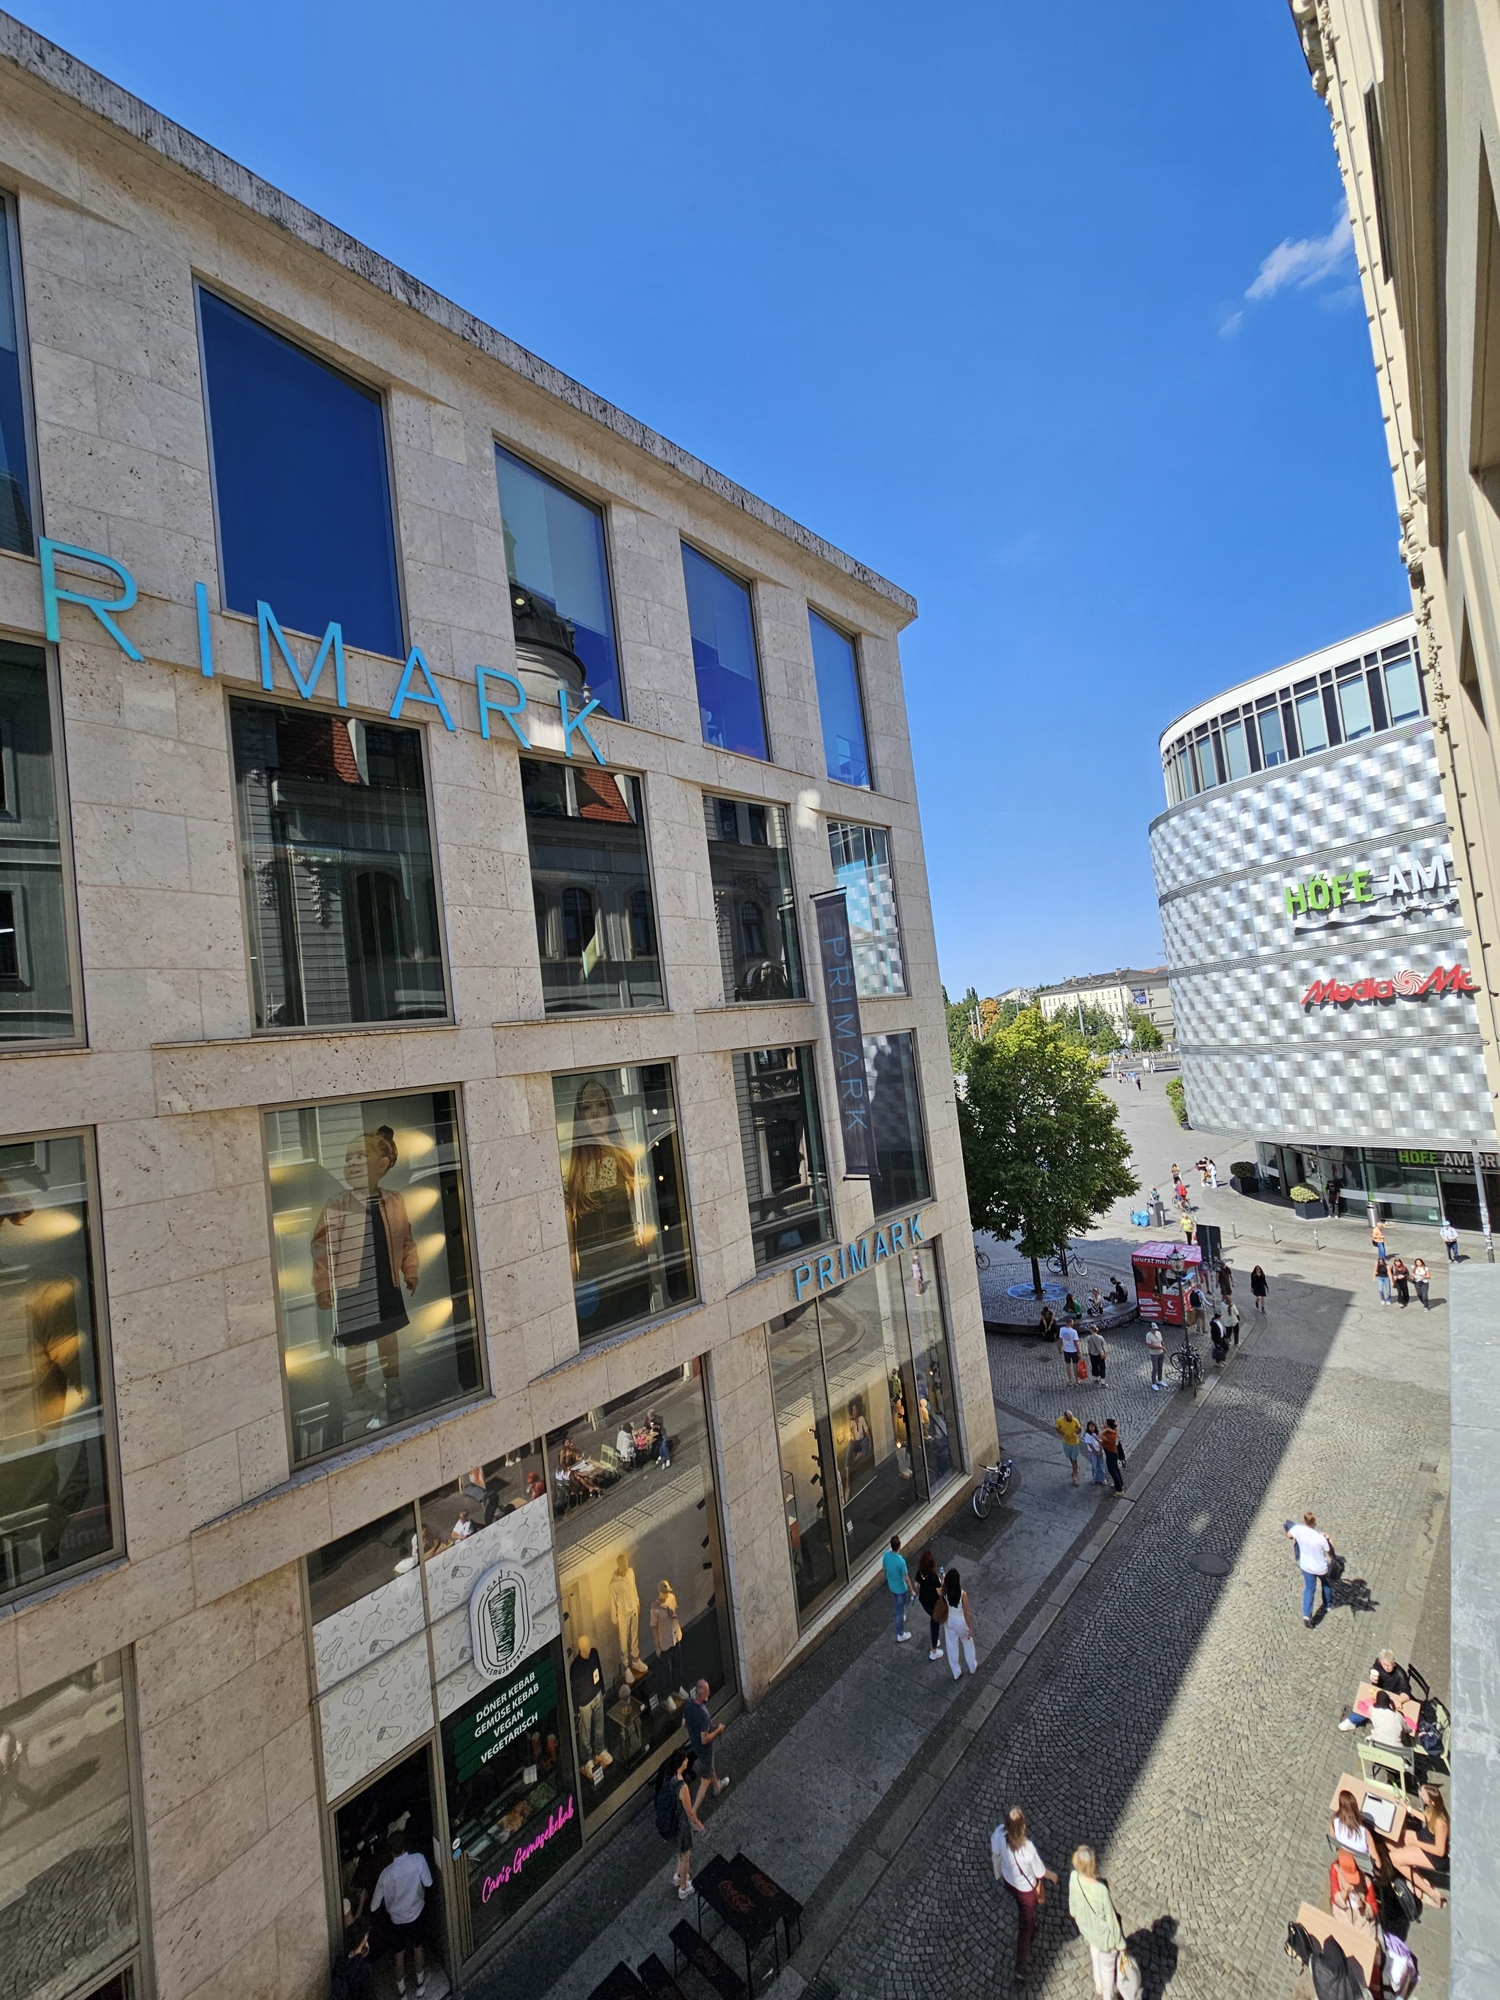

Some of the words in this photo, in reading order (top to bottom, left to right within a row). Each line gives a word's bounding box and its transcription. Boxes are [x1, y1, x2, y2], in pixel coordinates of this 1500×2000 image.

[39, 537, 608, 766] RIMARK
[1285, 870, 1374, 914] HÖFE
[1386, 855, 1449, 897] AM
[1301, 977, 1394, 1005] Media
[825, 936, 868, 1130] PRIMARK
[1398, 1149, 1439, 1165] HÖFE
[1444, 1153, 1469, 1167] AM
[795, 1213, 925, 1302] PRIMARK
[474, 1703, 511, 1738] GEMÜSE
[512, 1683, 539, 1710] KEBAB
[476, 1693, 507, 1723] DÖNER
[508, 1671, 536, 1698] KEBAB
[493, 1708, 524, 1738] VEGAN
[480, 1711, 538, 1764] VEGETARISCH
[482, 1866, 512, 1904] Can's
